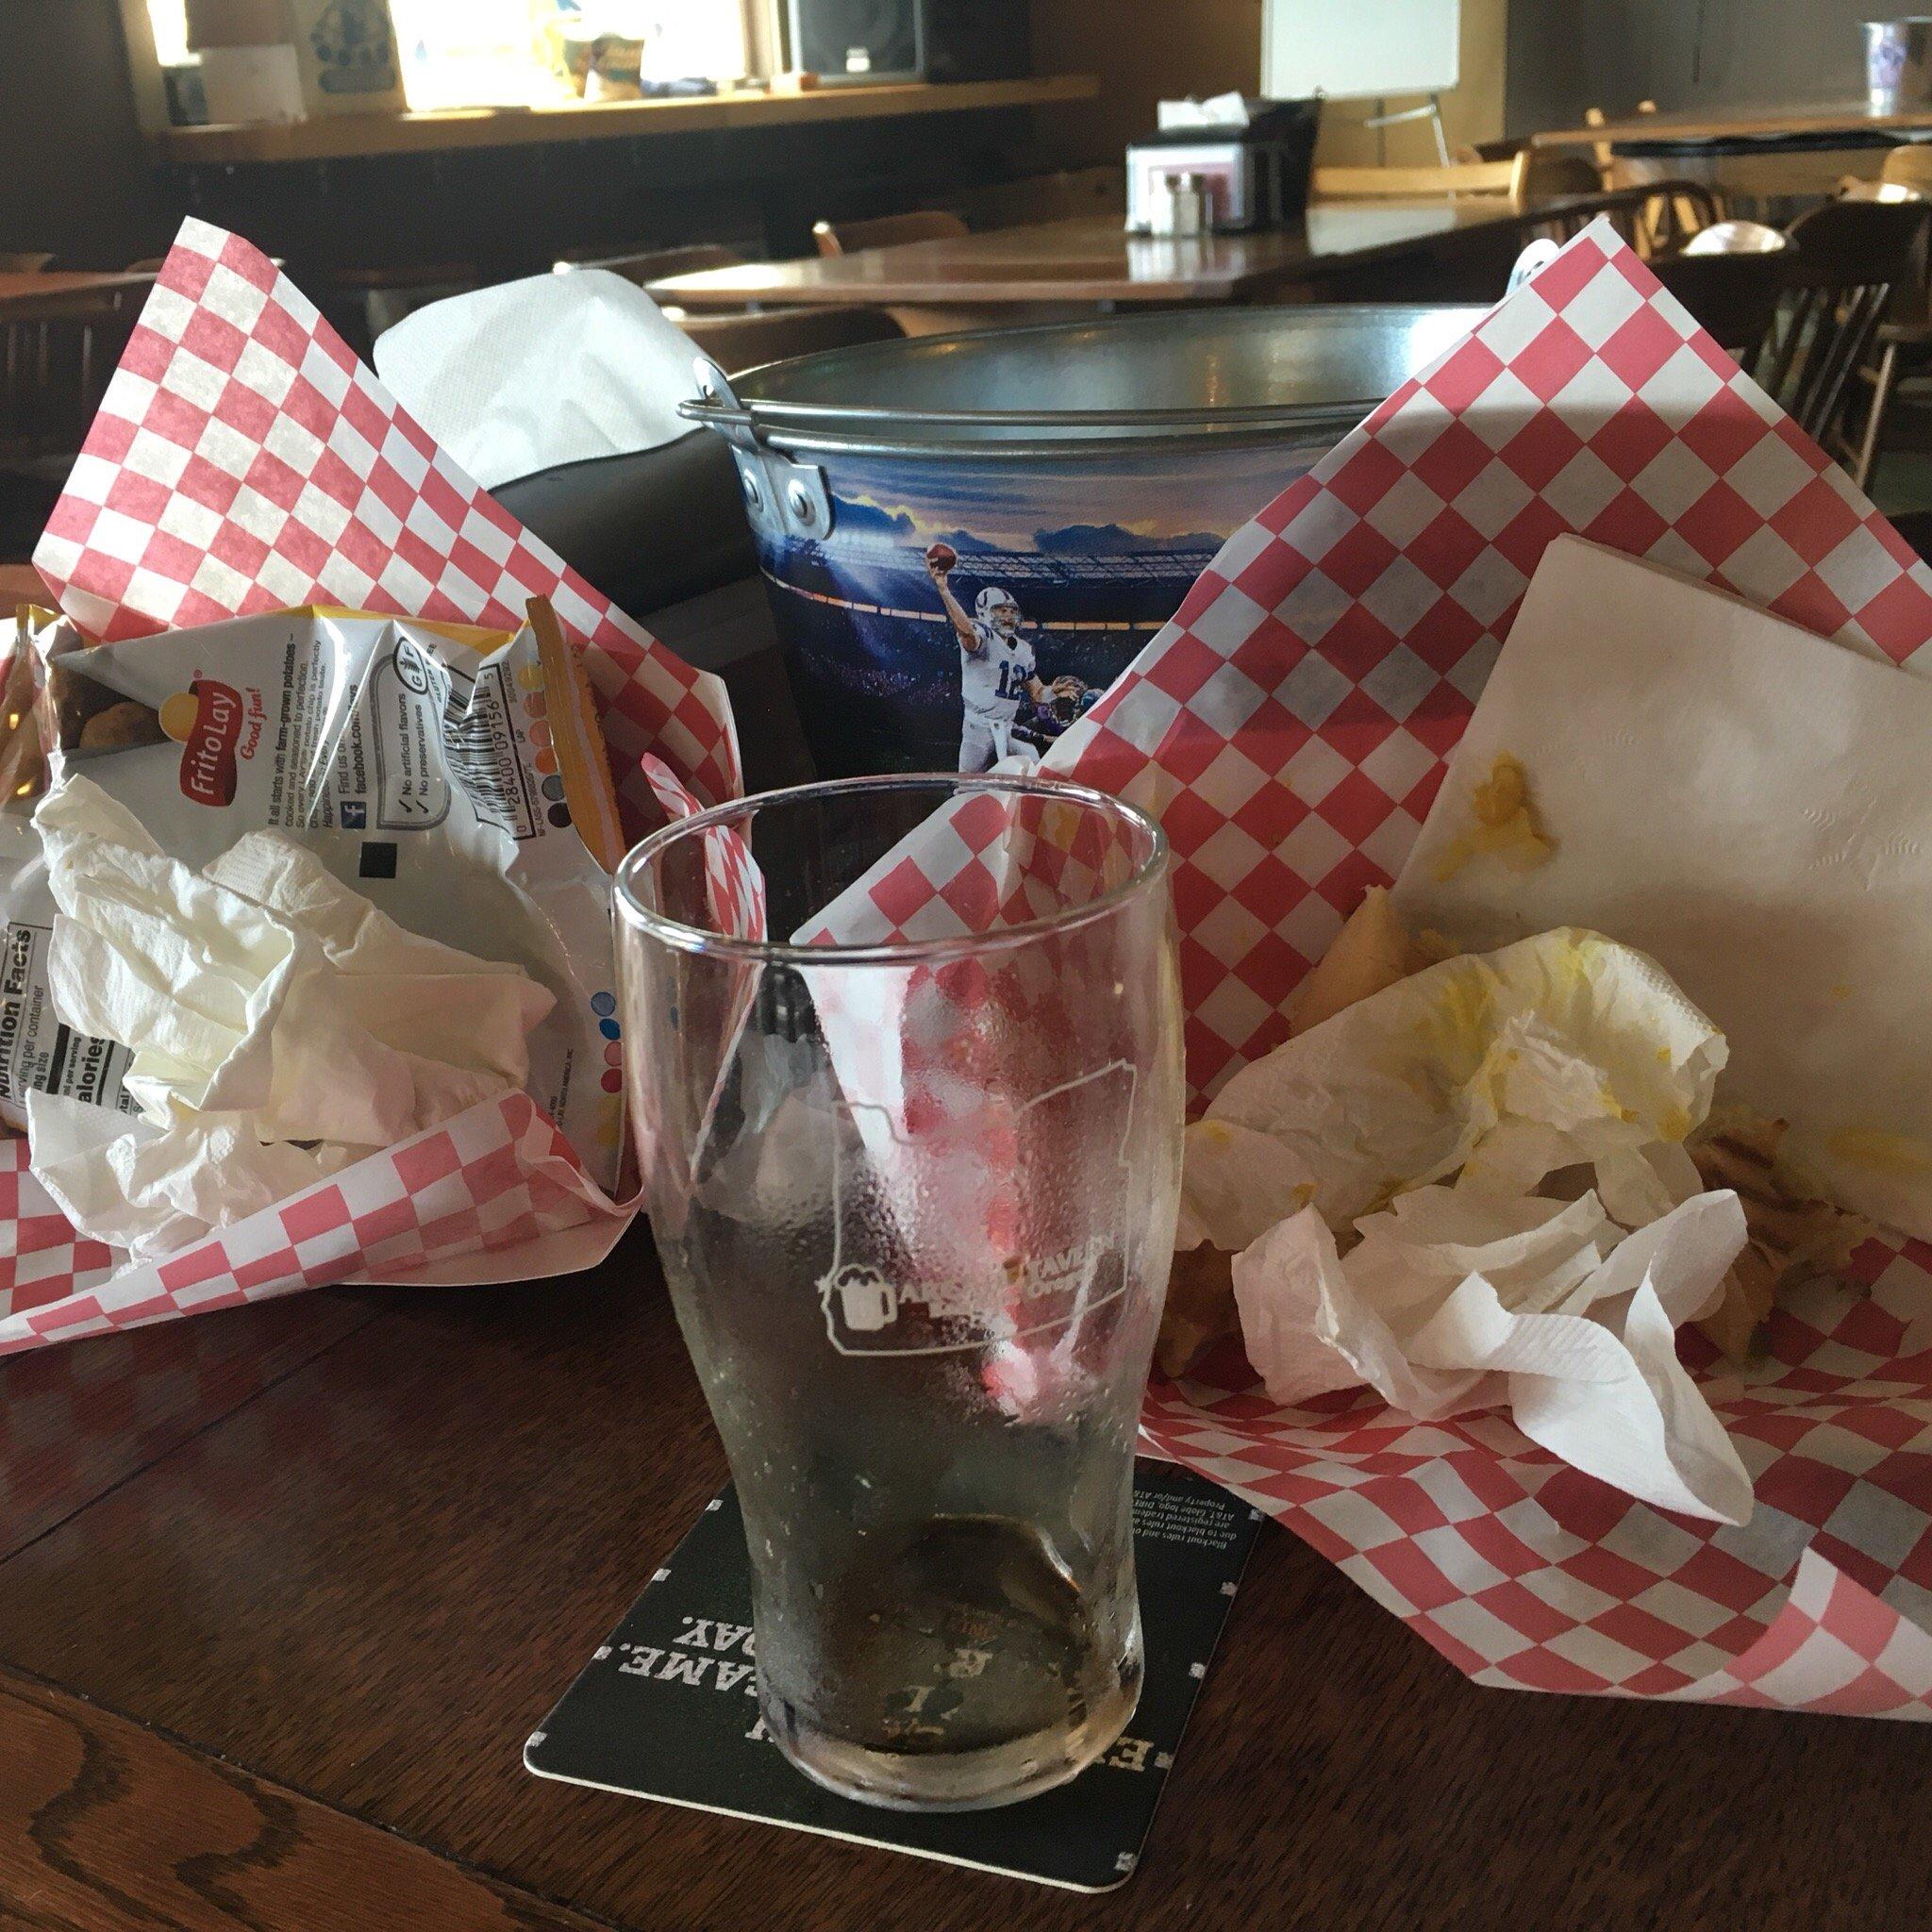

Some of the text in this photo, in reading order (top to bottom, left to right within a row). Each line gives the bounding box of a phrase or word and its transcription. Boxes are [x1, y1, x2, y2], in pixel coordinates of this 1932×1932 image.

[282, 642, 296, 689] potatoes
[311, 640, 322, 682] perfectly
[403, 644, 424, 688] G F
[484, 672, 494, 680] 5
[994, 659, 1027, 701] 12
[308, 692, 316, 715] chip
[314, 691, 324, 722] potato
[240, 687, 268, 760] Good fun!
[275, 690, 291, 751] farm-grown
[293, 712, 303, 723] to
[487, 700, 508, 750] 09156
[304, 717, 314, 747] potato
[291, 724, 302, 771] seasoned
[398, 692, 412, 796] No artificial flavors
[415, 704, 430, 796] No preservatives
[274, 754, 286, 774] with
[339, 755, 348, 770] us
[271, 775, 284, 803] starts
[288, 771, 297, 791] and
[338, 771, 351, 794] Find
[498, 757, 522, 806] 28400
[269, 804, 281, 818] all
[285, 791, 295, 827] cooked
[297, 786, 307, 813] every
[295, 816, 306, 828] So
[3, 929, 31, 995] Facts
[27, 984, 44, 1038] container
[22, 1039, 36, 1059] per
[67, 1037, 83, 1069] serving
[37, 1051, 50, 1074] size
[75, 1037, 106, 1104] alories
[65, 1068, 75, 1085] per
[1154, 1491, 1185, 1503] and/or
[1184, 1495, 1225, 1511] Property
[1164, 1513, 1214, 1526] registered
[1180, 1506, 1208, 1518] Globe
[1141, 1519, 1165, 1530] rules
[1141, 1528, 1161, 1539] and
[1162, 1531, 1186, 1541] rules
[1165, 1523, 1208, 1536] blackout
[1207, 1528, 1218, 1538] to
[1214, 1521, 1231, 1529] are
[1187, 1536, 1227, 1550] Blackout
[1219, 1532, 1238, 1541] due
